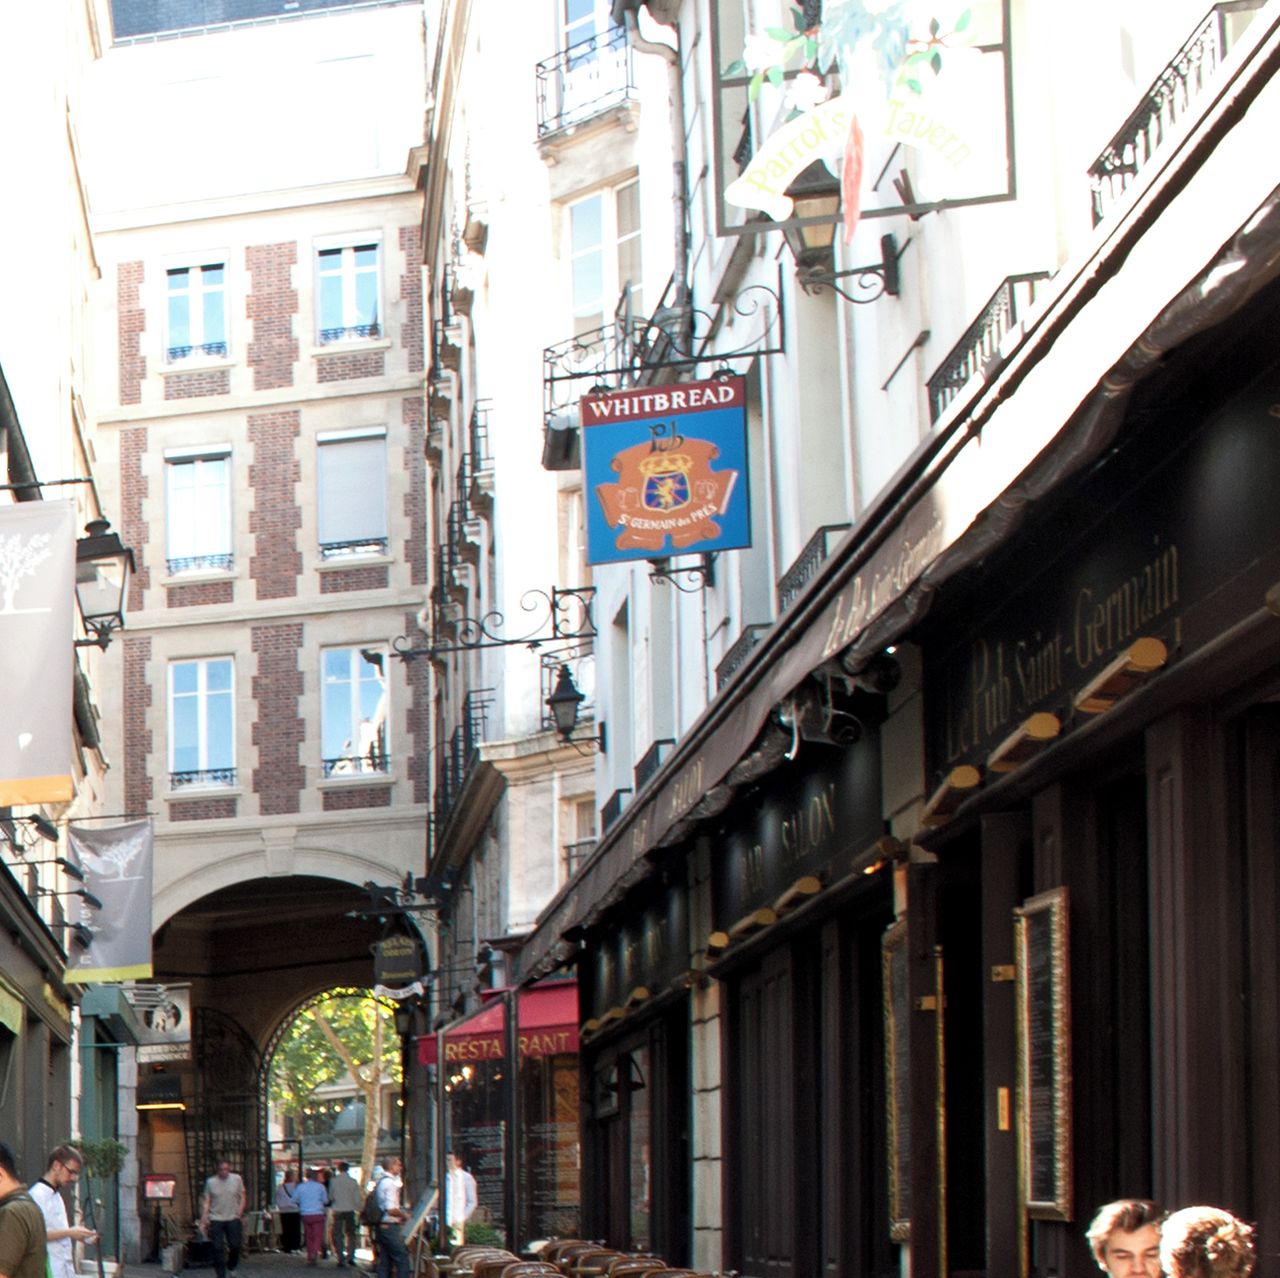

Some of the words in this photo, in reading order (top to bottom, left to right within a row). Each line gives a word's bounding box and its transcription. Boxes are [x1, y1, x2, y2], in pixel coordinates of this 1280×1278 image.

[745, 111, 847, 196] Parrot's
[883, 98, 973, 170] Tavern
[589, 386, 735, 418] WHITBREAD
[649, 421, 684, 454] Pub
[971, 637, 1011, 745] Pub
[444, 1032, 570, 1061] RESTARANT
